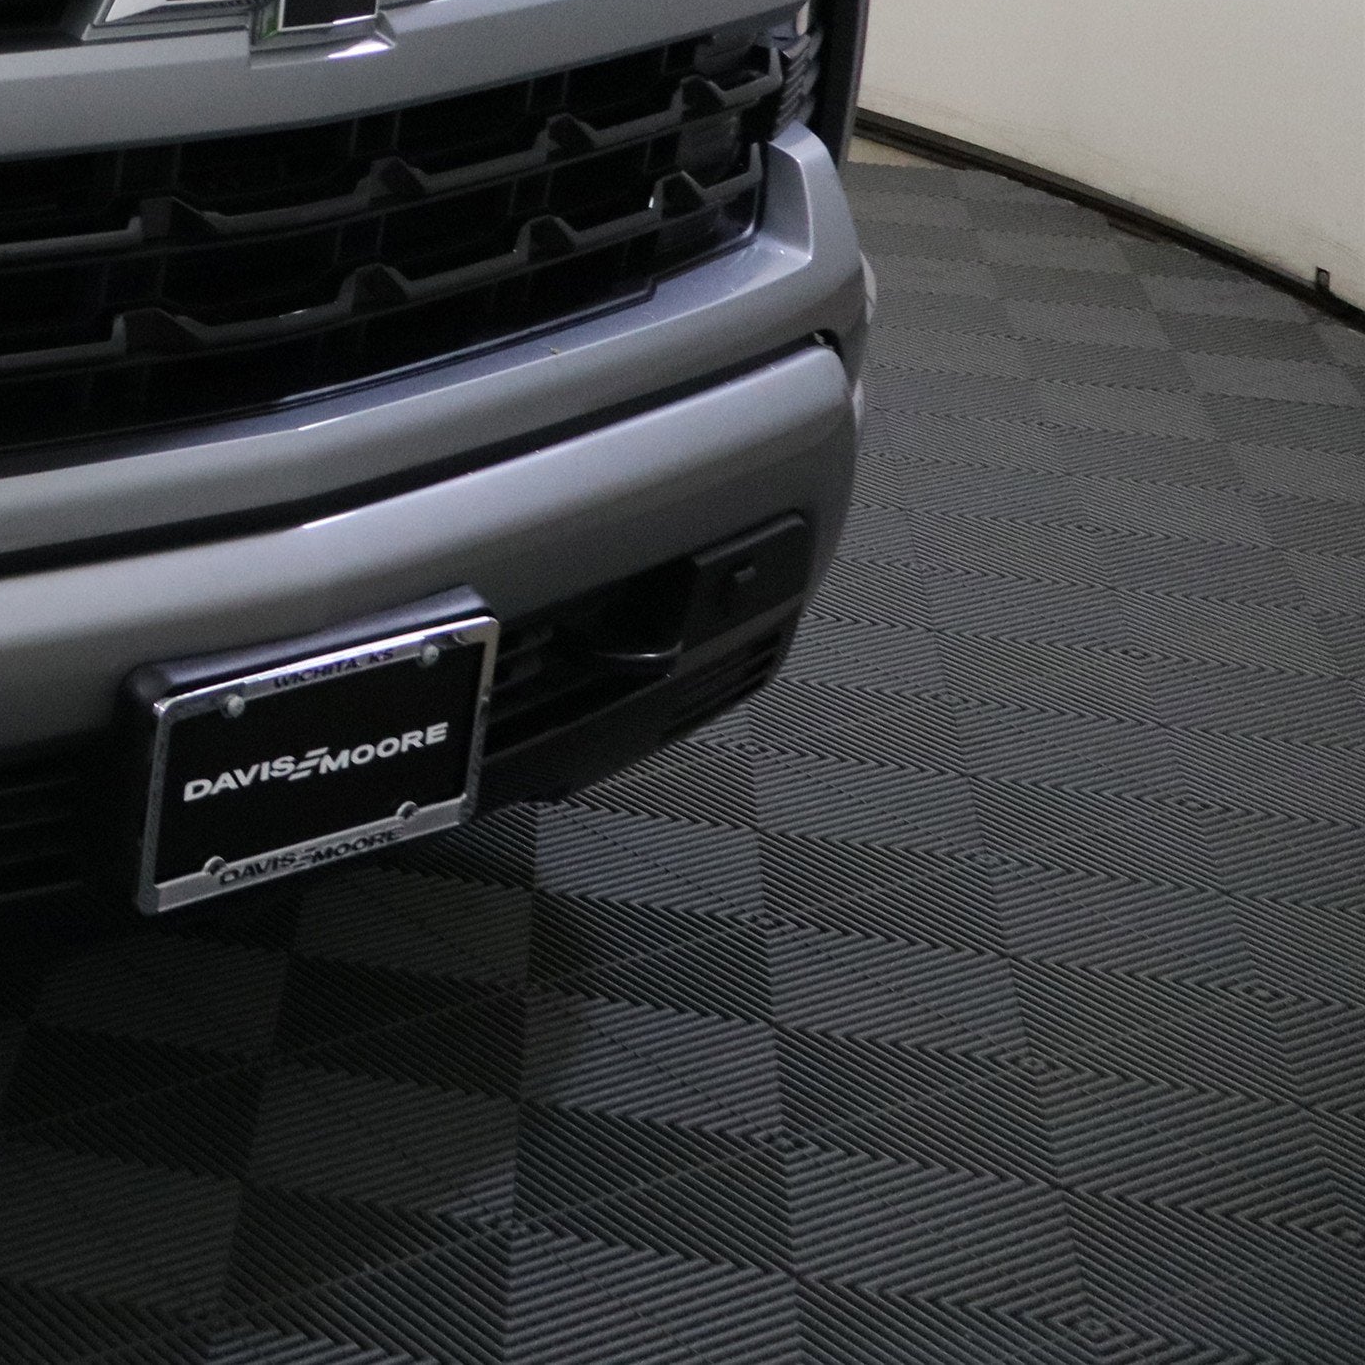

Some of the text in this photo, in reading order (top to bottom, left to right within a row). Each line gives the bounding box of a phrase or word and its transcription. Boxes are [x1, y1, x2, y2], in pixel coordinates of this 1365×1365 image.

[183, 721, 449, 802] DAVIS MOORE
[219, 826, 405, 886] DAVIS MOORE
